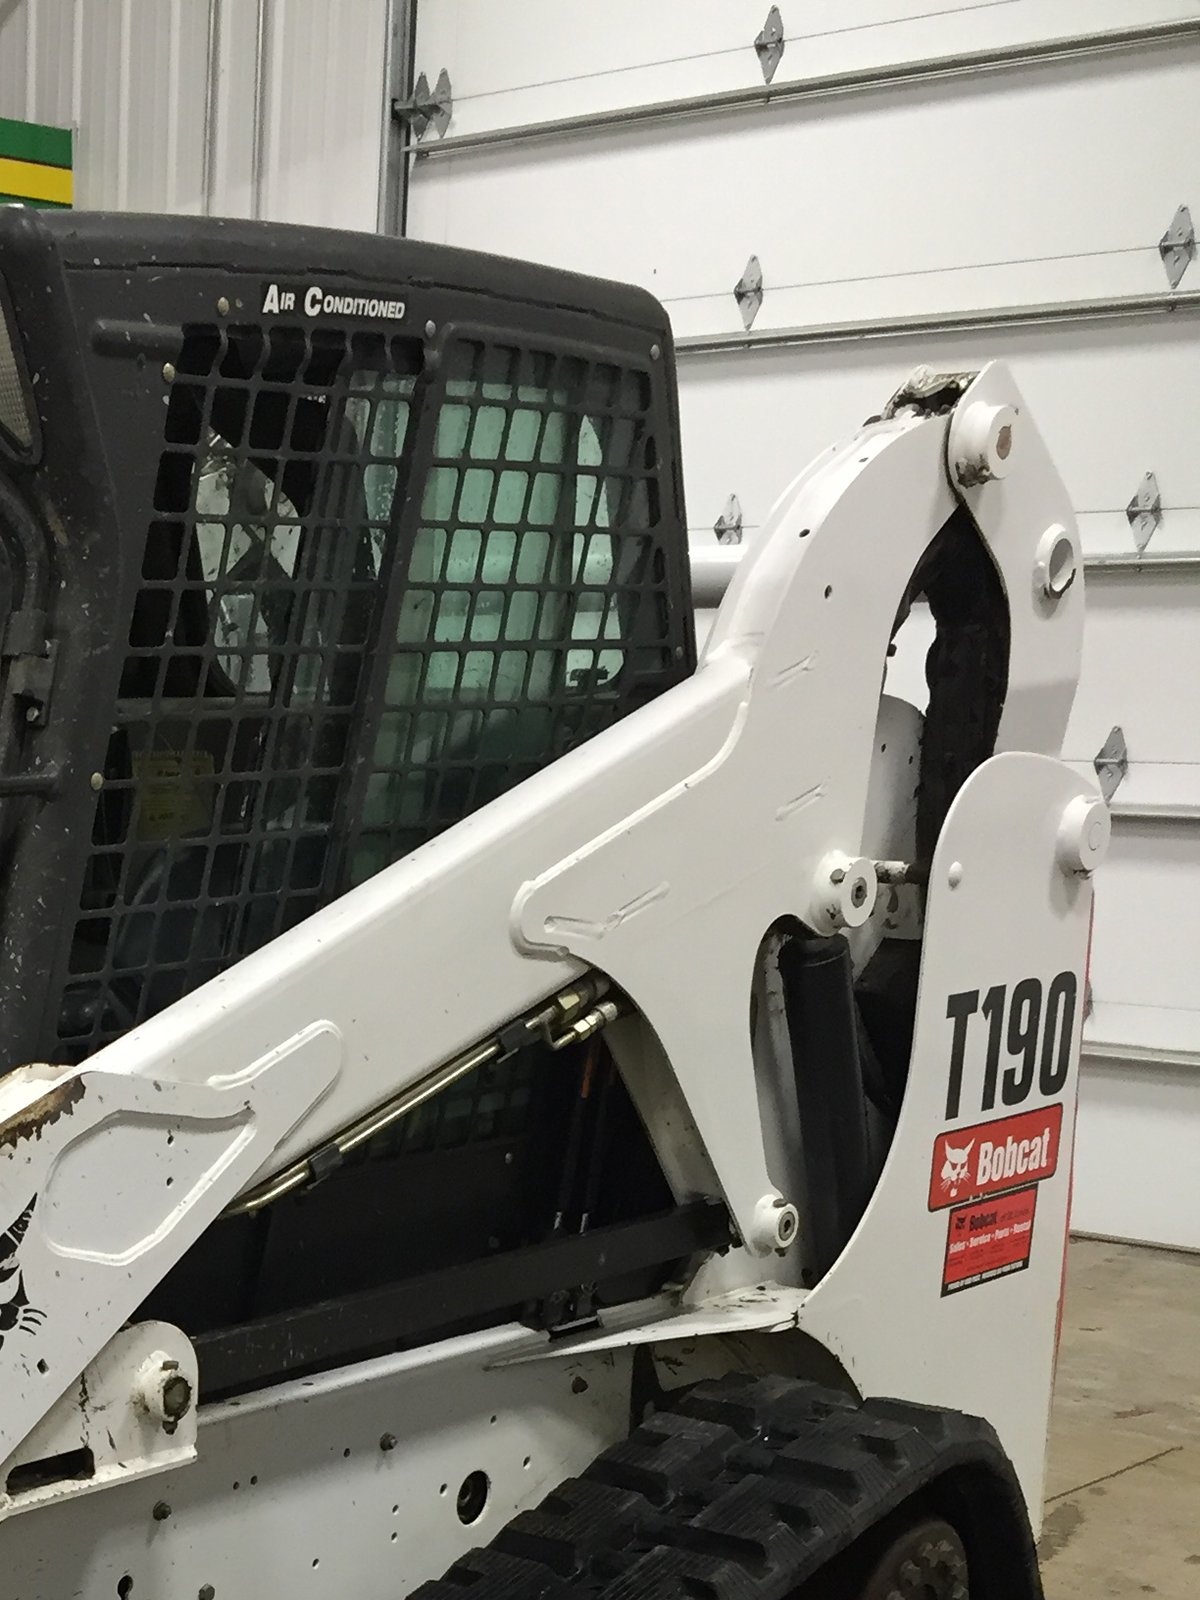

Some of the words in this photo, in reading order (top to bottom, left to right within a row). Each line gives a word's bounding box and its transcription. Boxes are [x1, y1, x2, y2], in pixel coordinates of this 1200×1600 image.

[262, 284, 296, 314] AIR
[304, 286, 406, 319] CONDITIONED
[945, 971, 1077, 1121] T190
[976, 1127, 1050, 1186] Bobcat
